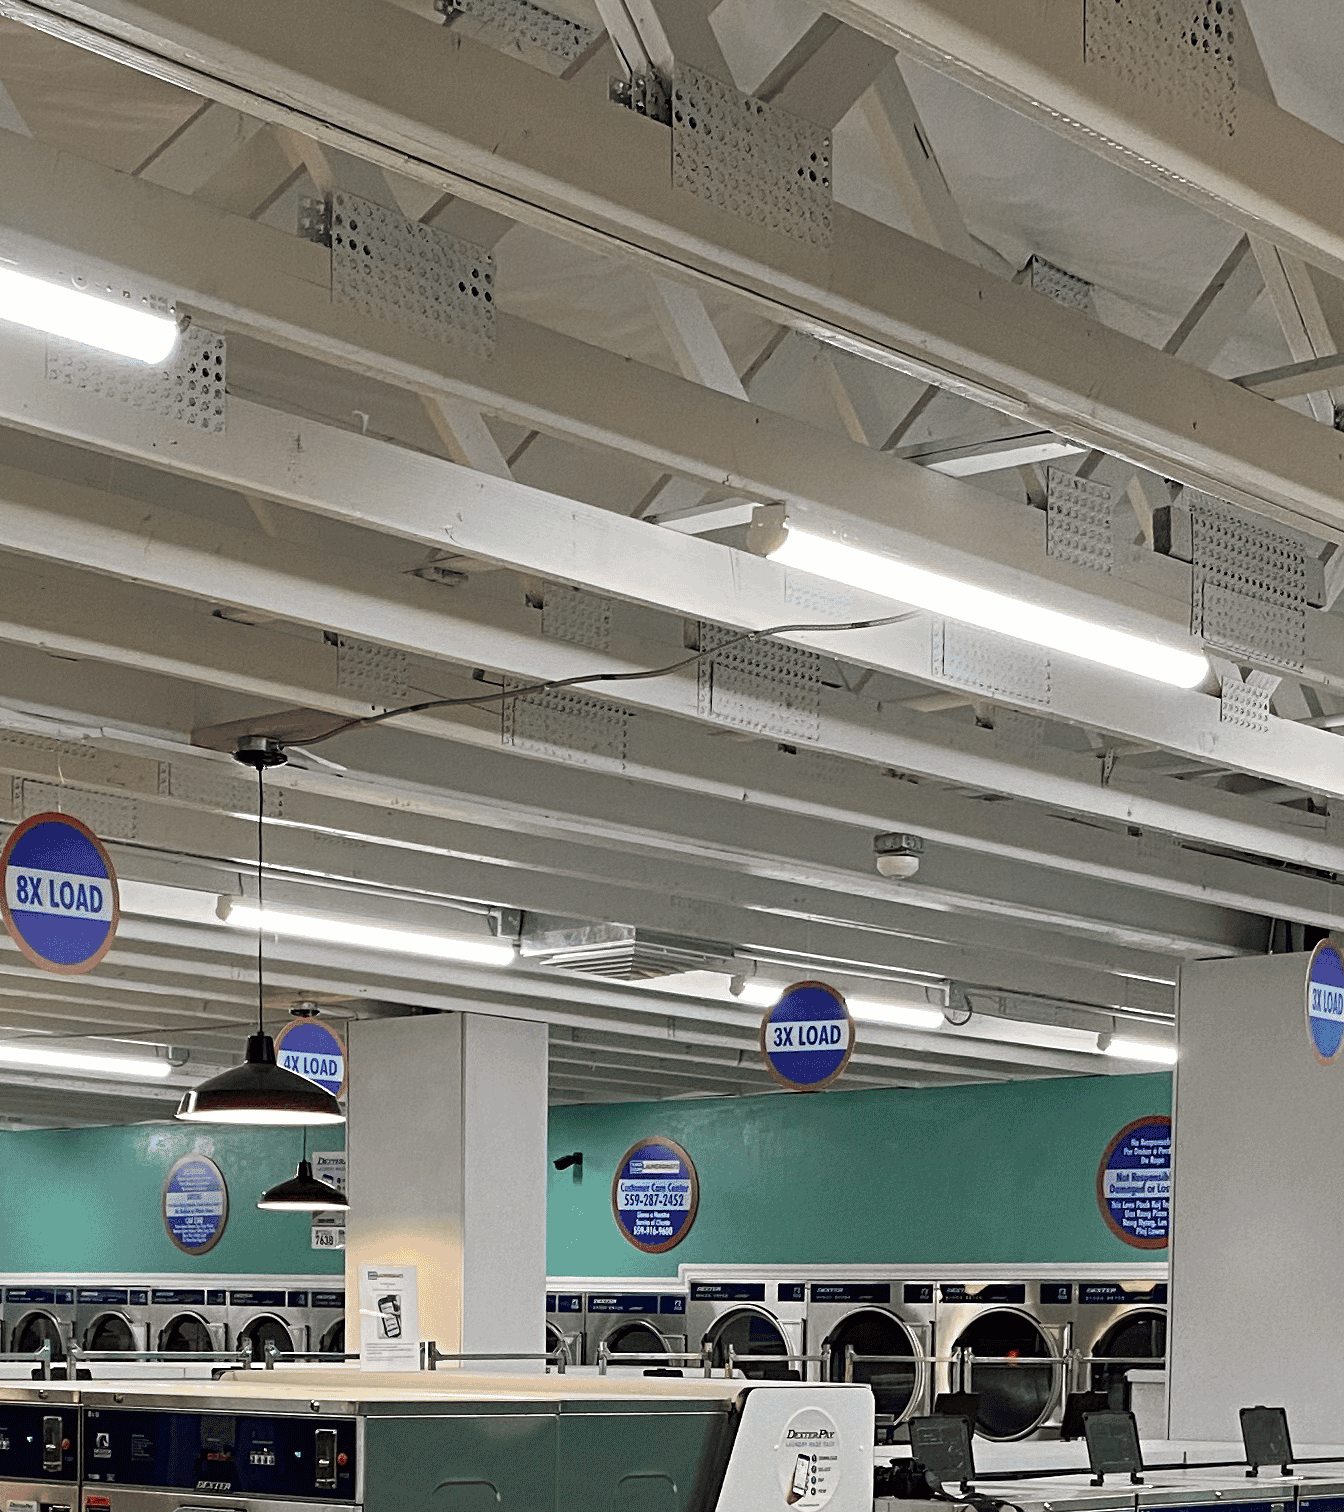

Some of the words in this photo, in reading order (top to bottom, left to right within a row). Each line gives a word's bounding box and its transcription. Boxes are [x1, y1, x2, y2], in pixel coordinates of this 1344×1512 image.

[16, 874, 43, 906] 8X
[49, 879, 103, 913] LOAD
[1324, 991, 1343, 1015] LOAD
[773, 1026, 793, 1046] 3X
[798, 1025, 841, 1045] LOAD
[284, 1055, 300, 1073] 4X
[303, 1057, 337, 1076] LOAD
[624, 1194, 684, 1206] 559-287-2452
[196, 1480, 231, 1490] DEXTER
